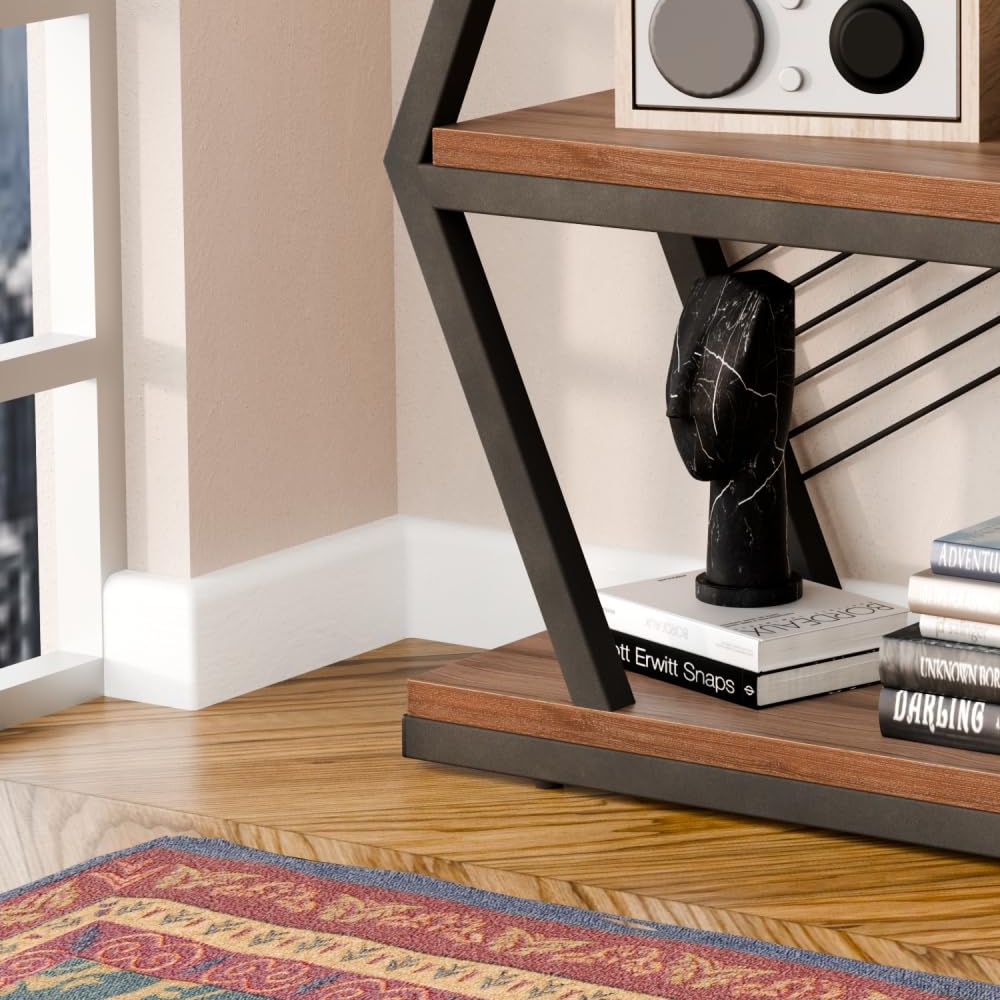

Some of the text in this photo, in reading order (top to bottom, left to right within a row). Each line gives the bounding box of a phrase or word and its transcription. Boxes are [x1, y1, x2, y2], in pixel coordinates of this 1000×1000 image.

[635, 646, 679, 677] Erwitt
[683, 661, 735, 694] Snaps
[920, 656, 978, 686] UNKNOWN
[892, 689, 986, 734] DARLING
